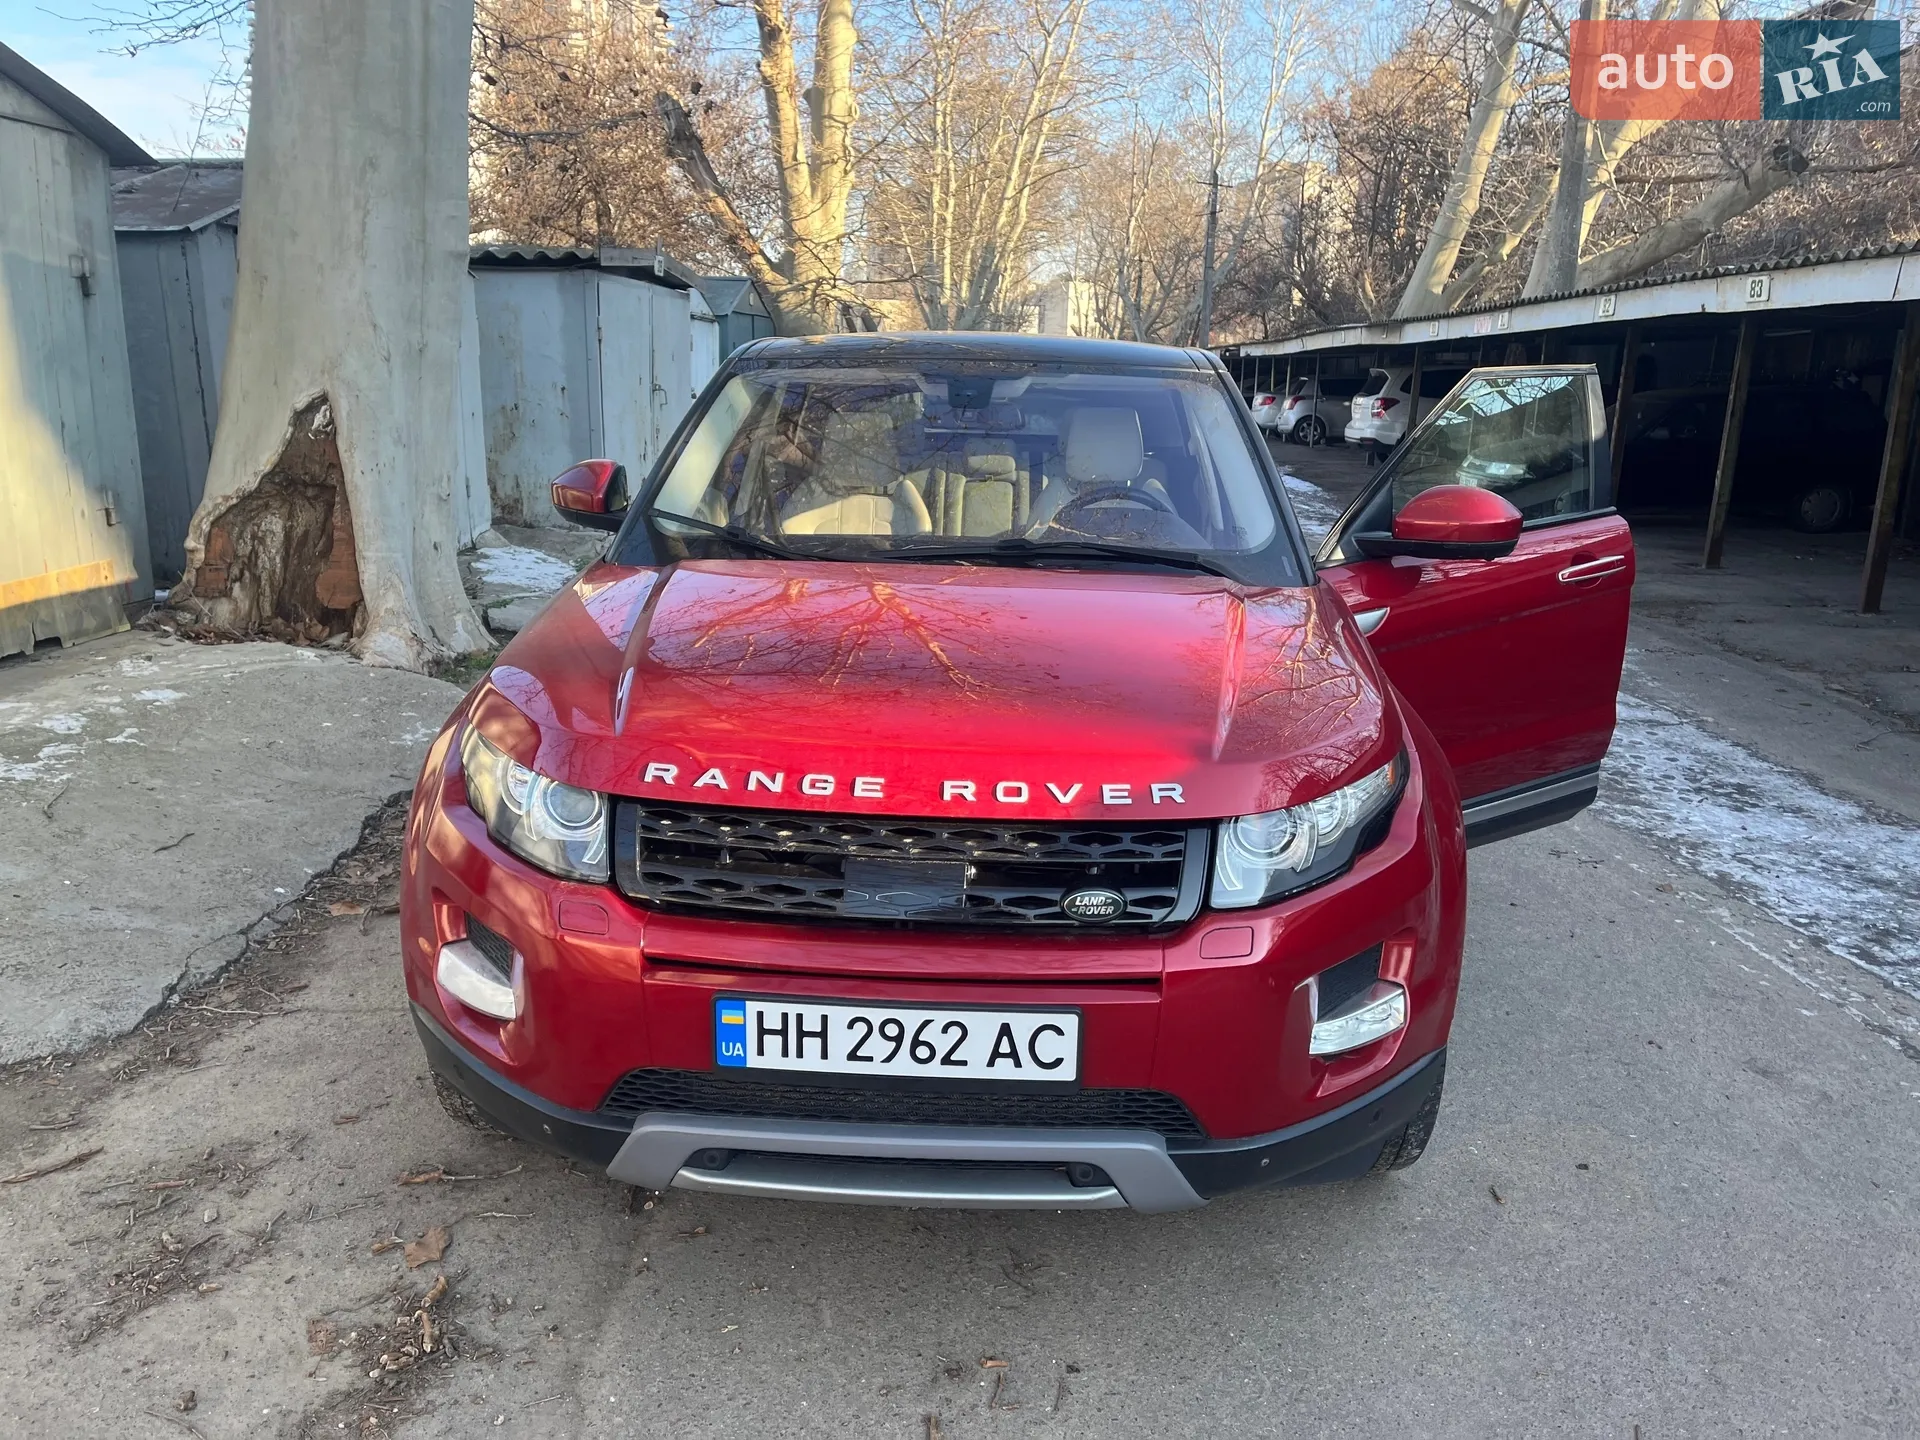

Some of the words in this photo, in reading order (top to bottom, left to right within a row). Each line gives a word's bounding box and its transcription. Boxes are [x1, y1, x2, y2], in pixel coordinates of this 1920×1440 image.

[1749, 279, 1764, 299] 83
[643, 762, 886, 798] RANGE
[940, 780, 1186, 805] ROVER
[1075, 896, 1105, 905] LAND
[1077, 905, 1114, 914] ROVER
[721, 1041, 745, 1057] UA
[756, 1010, 829, 1060] HH
[846, 1016, 969, 1067] 2962
[985, 1022, 1066, 1070] AC
